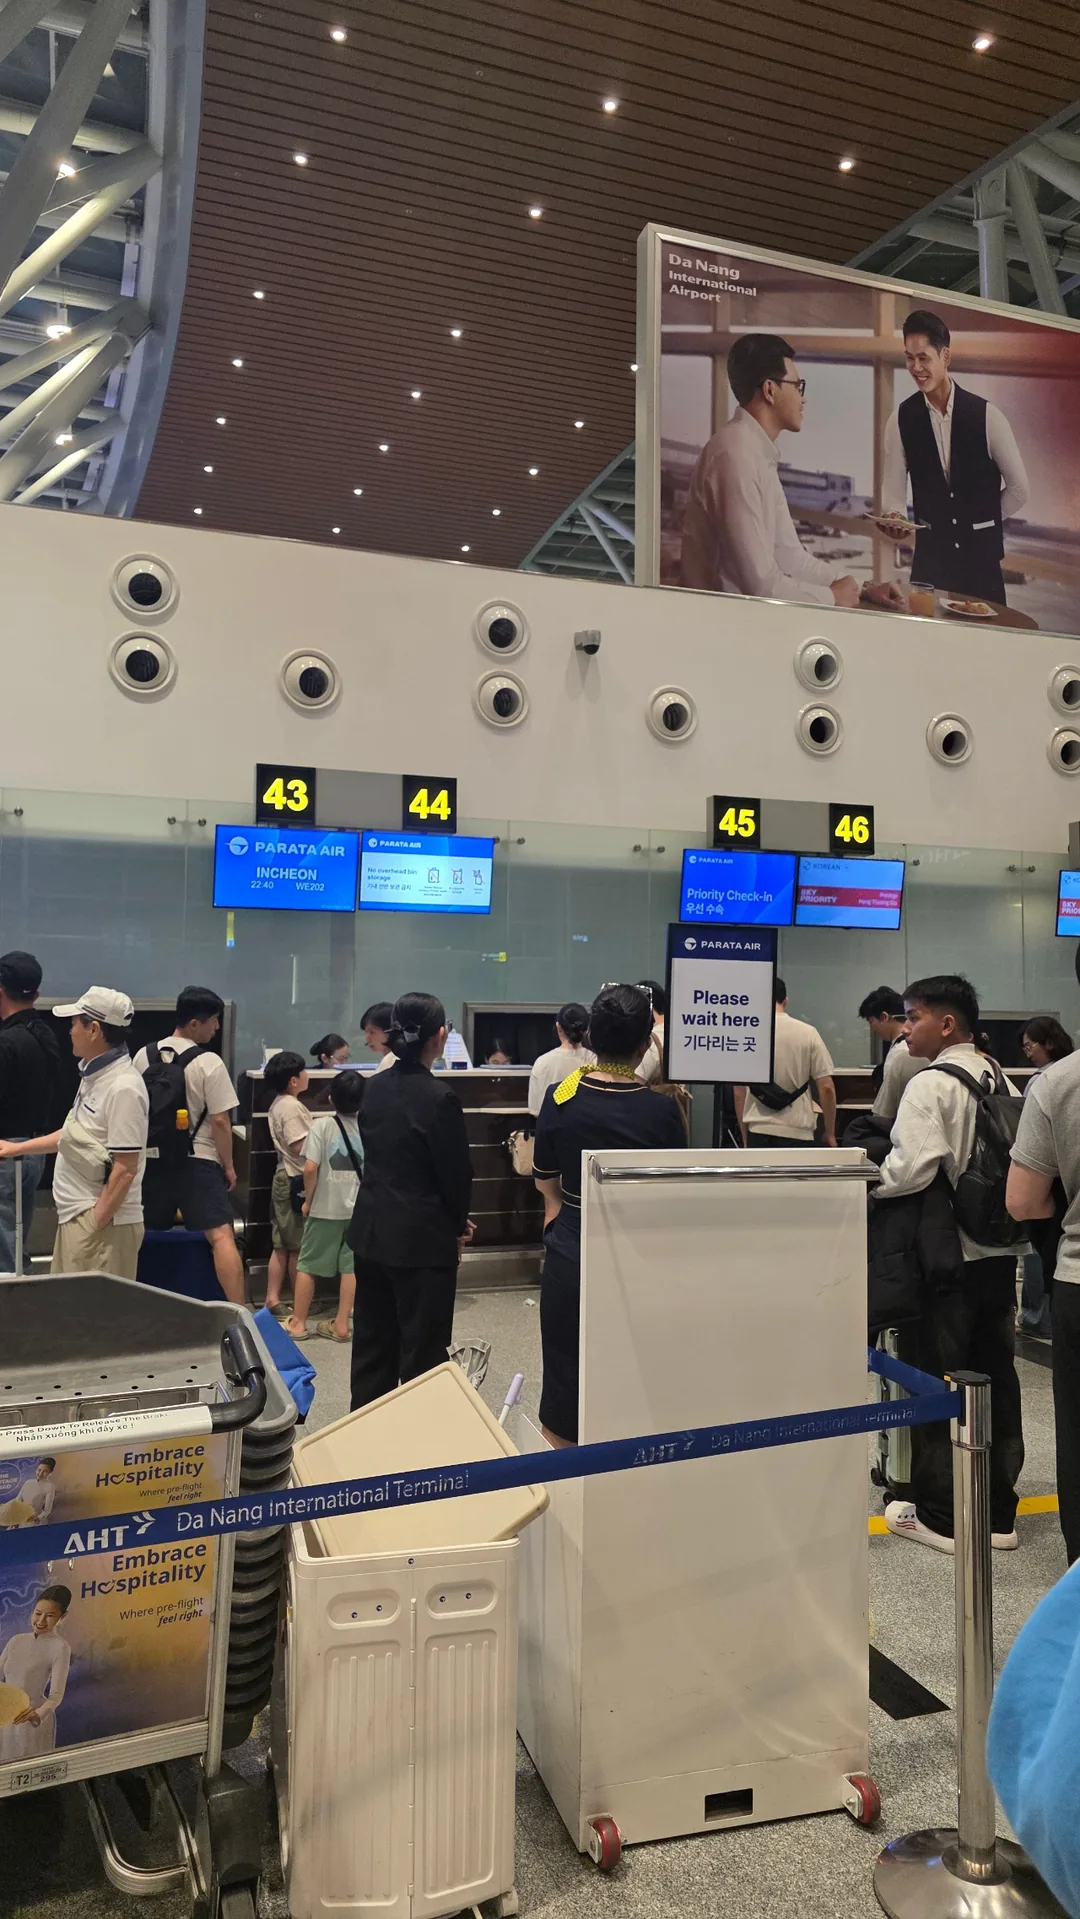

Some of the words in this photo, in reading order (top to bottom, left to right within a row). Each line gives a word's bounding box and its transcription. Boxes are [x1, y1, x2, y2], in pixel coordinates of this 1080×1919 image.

[668, 253, 692, 269] Da
[695, 259, 740, 280] Nang
[669, 270, 757, 297] International
[669, 284, 721, 303] Airport
[262, 778, 309, 812] 43
[408, 788, 451, 820] 44
[718, 808, 756, 837] 45
[835, 815, 870, 844] 46
[255, 841, 317, 856] PARATA
[320, 844, 345, 857] AIR
[380, 840, 408, 848] PARATA
[409, 841, 422, 849] AIR
[256, 866, 317, 881] INCHEON
[250, 880, 274, 890] 22:40
[296, 882, 325, 892] WE202
[687, 888, 725, 902] Priority
[726, 889, 773, 902] Check-in
[800, 895, 837, 903] PRIORITY
[686, 902, 704, 915] 우선
[706, 903, 724, 915] 수속
[701, 941, 742, 949] PARATA
[744, 942, 761, 950] AIR
[693, 990, 749, 1005] Please
[682, 1011, 718, 1026] wait
[722, 1012, 760, 1027] here
[684, 1035, 739, 1052] 기다리는
[743, 1036, 756, 1052] 곳
[82, 1417, 121, 1427] Release
[633, 1442, 678, 1465] AHT
[712, 1432, 730, 1449] Da
[734, 1428, 771, 1445] Nang
[776, 1414, 860, 1438] International
[865, 1407, 916, 1424] erminal
[123, 1445, 205, 1466] Embrace
[139, 1487, 165, 1497] Where
[167, 1482, 202, 1496] pre-flight
[168, 1494, 182, 1503] feel
[184, 1491, 202, 1502] right
[64, 1525, 130, 1555] AHT
[177, 1512, 203, 1532] Da
[210, 1505, 263, 1527] Nang
[269, 1481, 390, 1518] International
[393, 1470, 469, 1499] Terminal
[113, 1543, 207, 1572] Embrace
[119, 1607, 154, 1621] Where
[157, 1596, 204, 1617] pre-flight
[158, 1615, 177, 1627] feel
[178, 1609, 203, 1624] right
[16, 1774, 29, 1785] T2
[40, 1773, 57, 1783] 295
